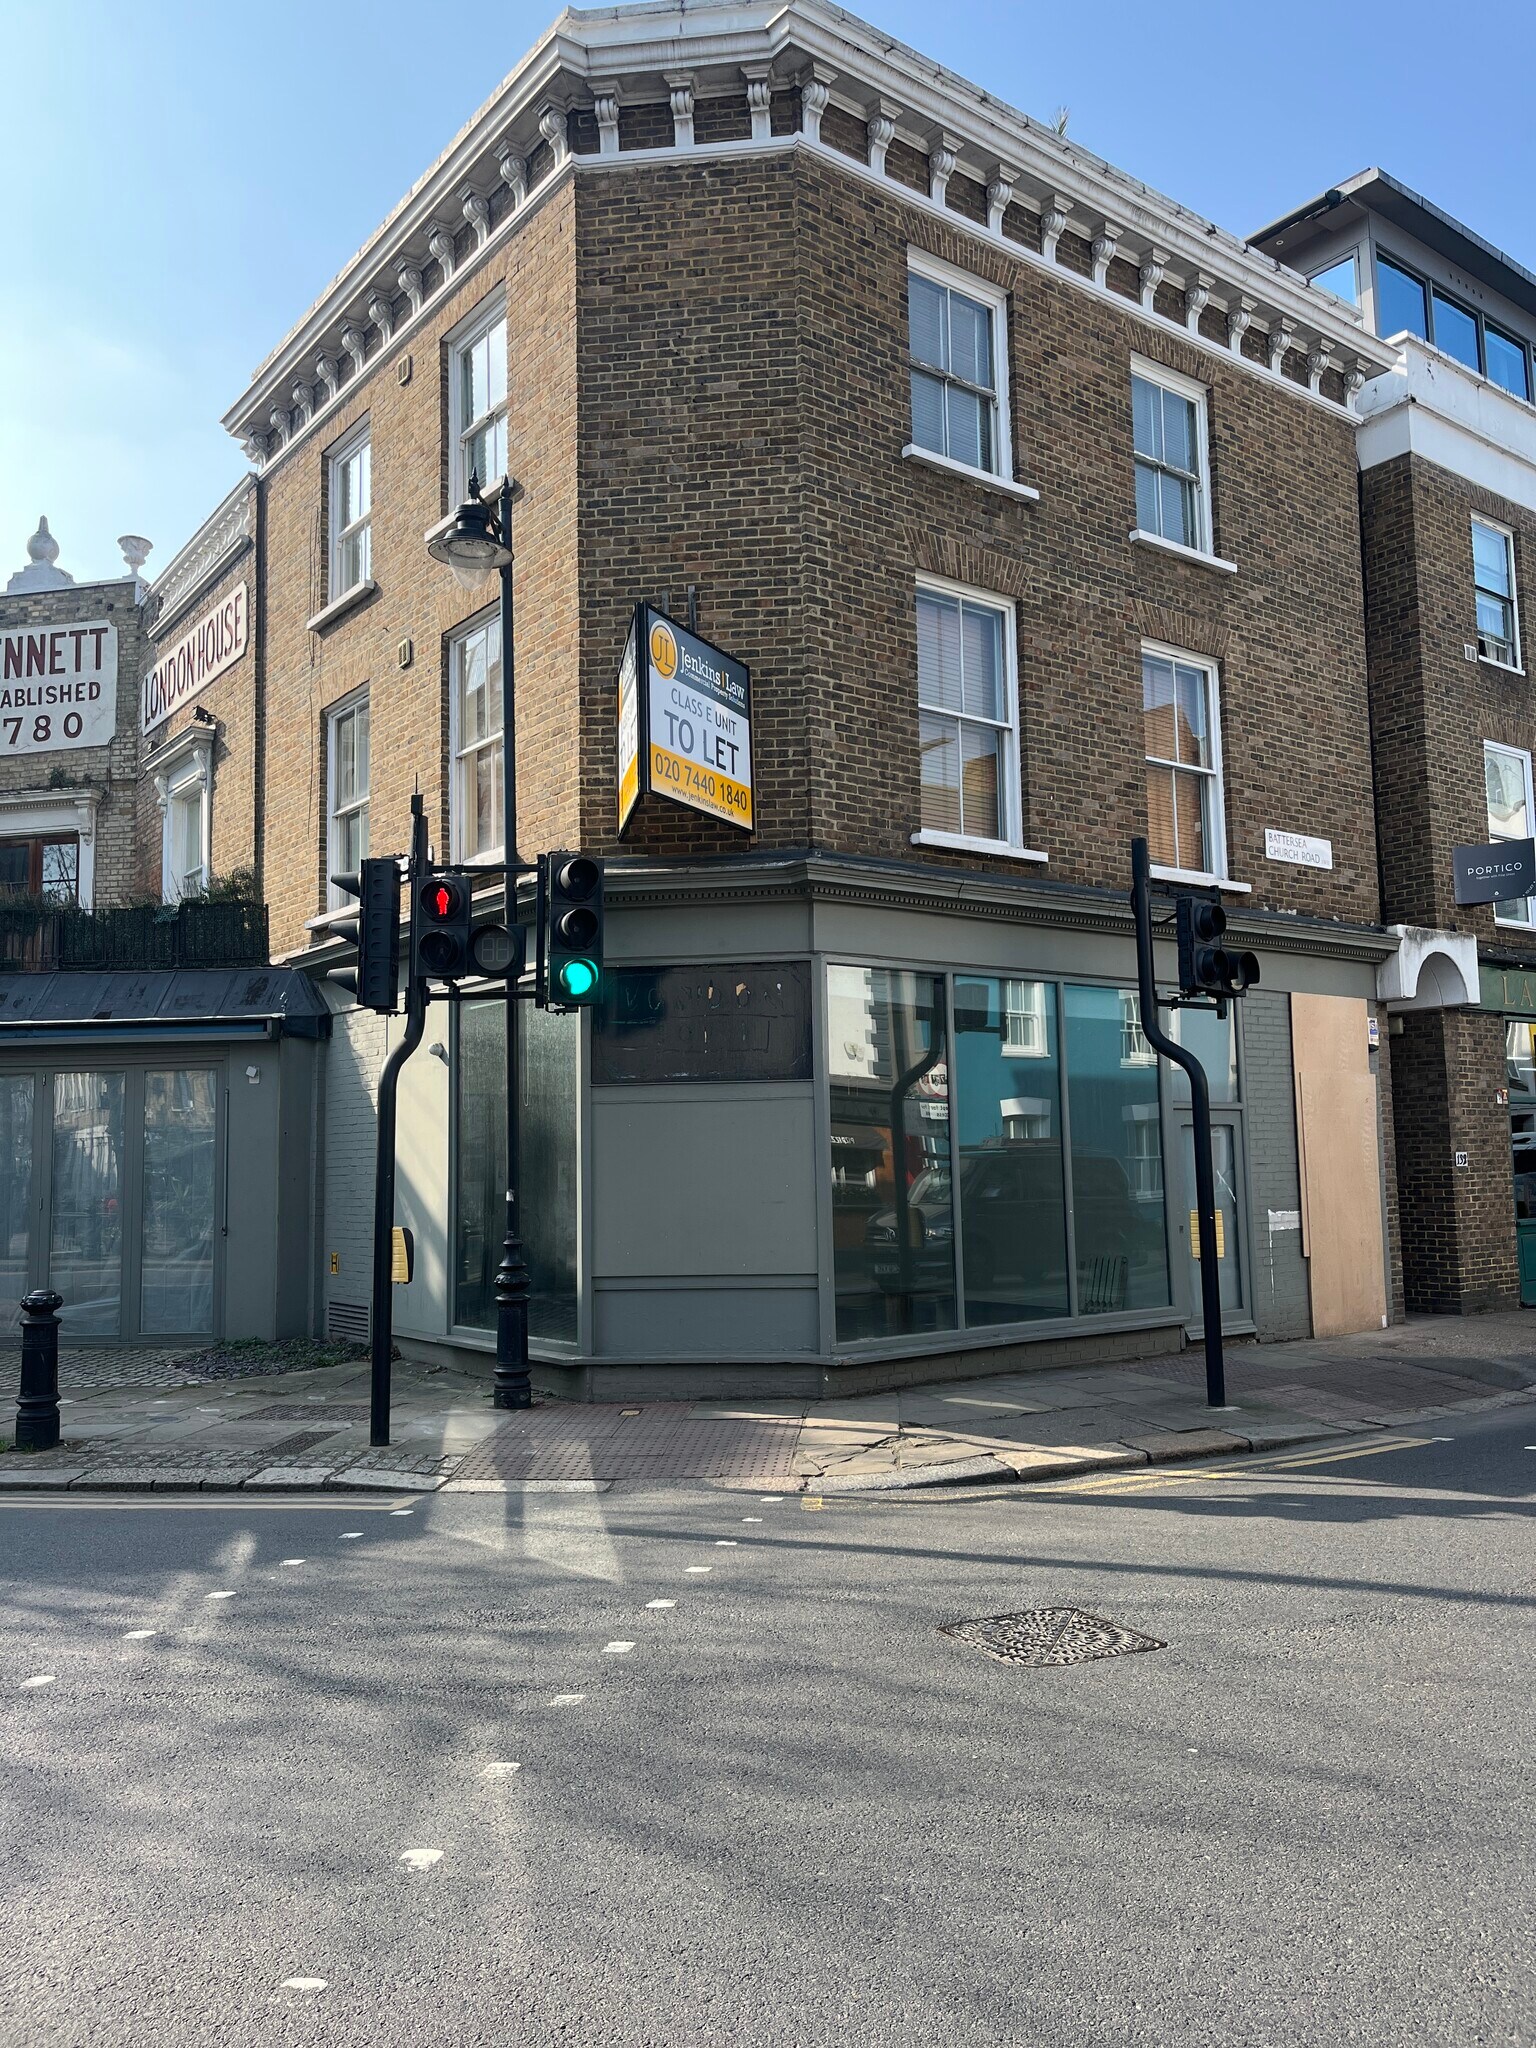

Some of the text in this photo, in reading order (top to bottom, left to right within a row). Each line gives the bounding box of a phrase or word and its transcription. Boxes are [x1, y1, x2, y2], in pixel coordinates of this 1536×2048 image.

[0, 627, 108, 679] NNETT
[145, 592, 242, 726] LONDON HOUSE
[0, 682, 100, 708] ABLISHED
[671, 688, 737, 736] CLASS E UNIT
[663, 709, 695, 754] TO
[703, 729, 739, 775] LET
[655, 752, 747, 811] 020 7440 1840
[672, 785, 734, 817] www.jenkinslaw.co.uk
[1268, 832, 1307, 849] BATTERSEA
[1268, 845, 1299, 860] CHURCH
[1301, 851, 1320, 864] ROAD
[1467, 862, 1522, 876] PORTICO
